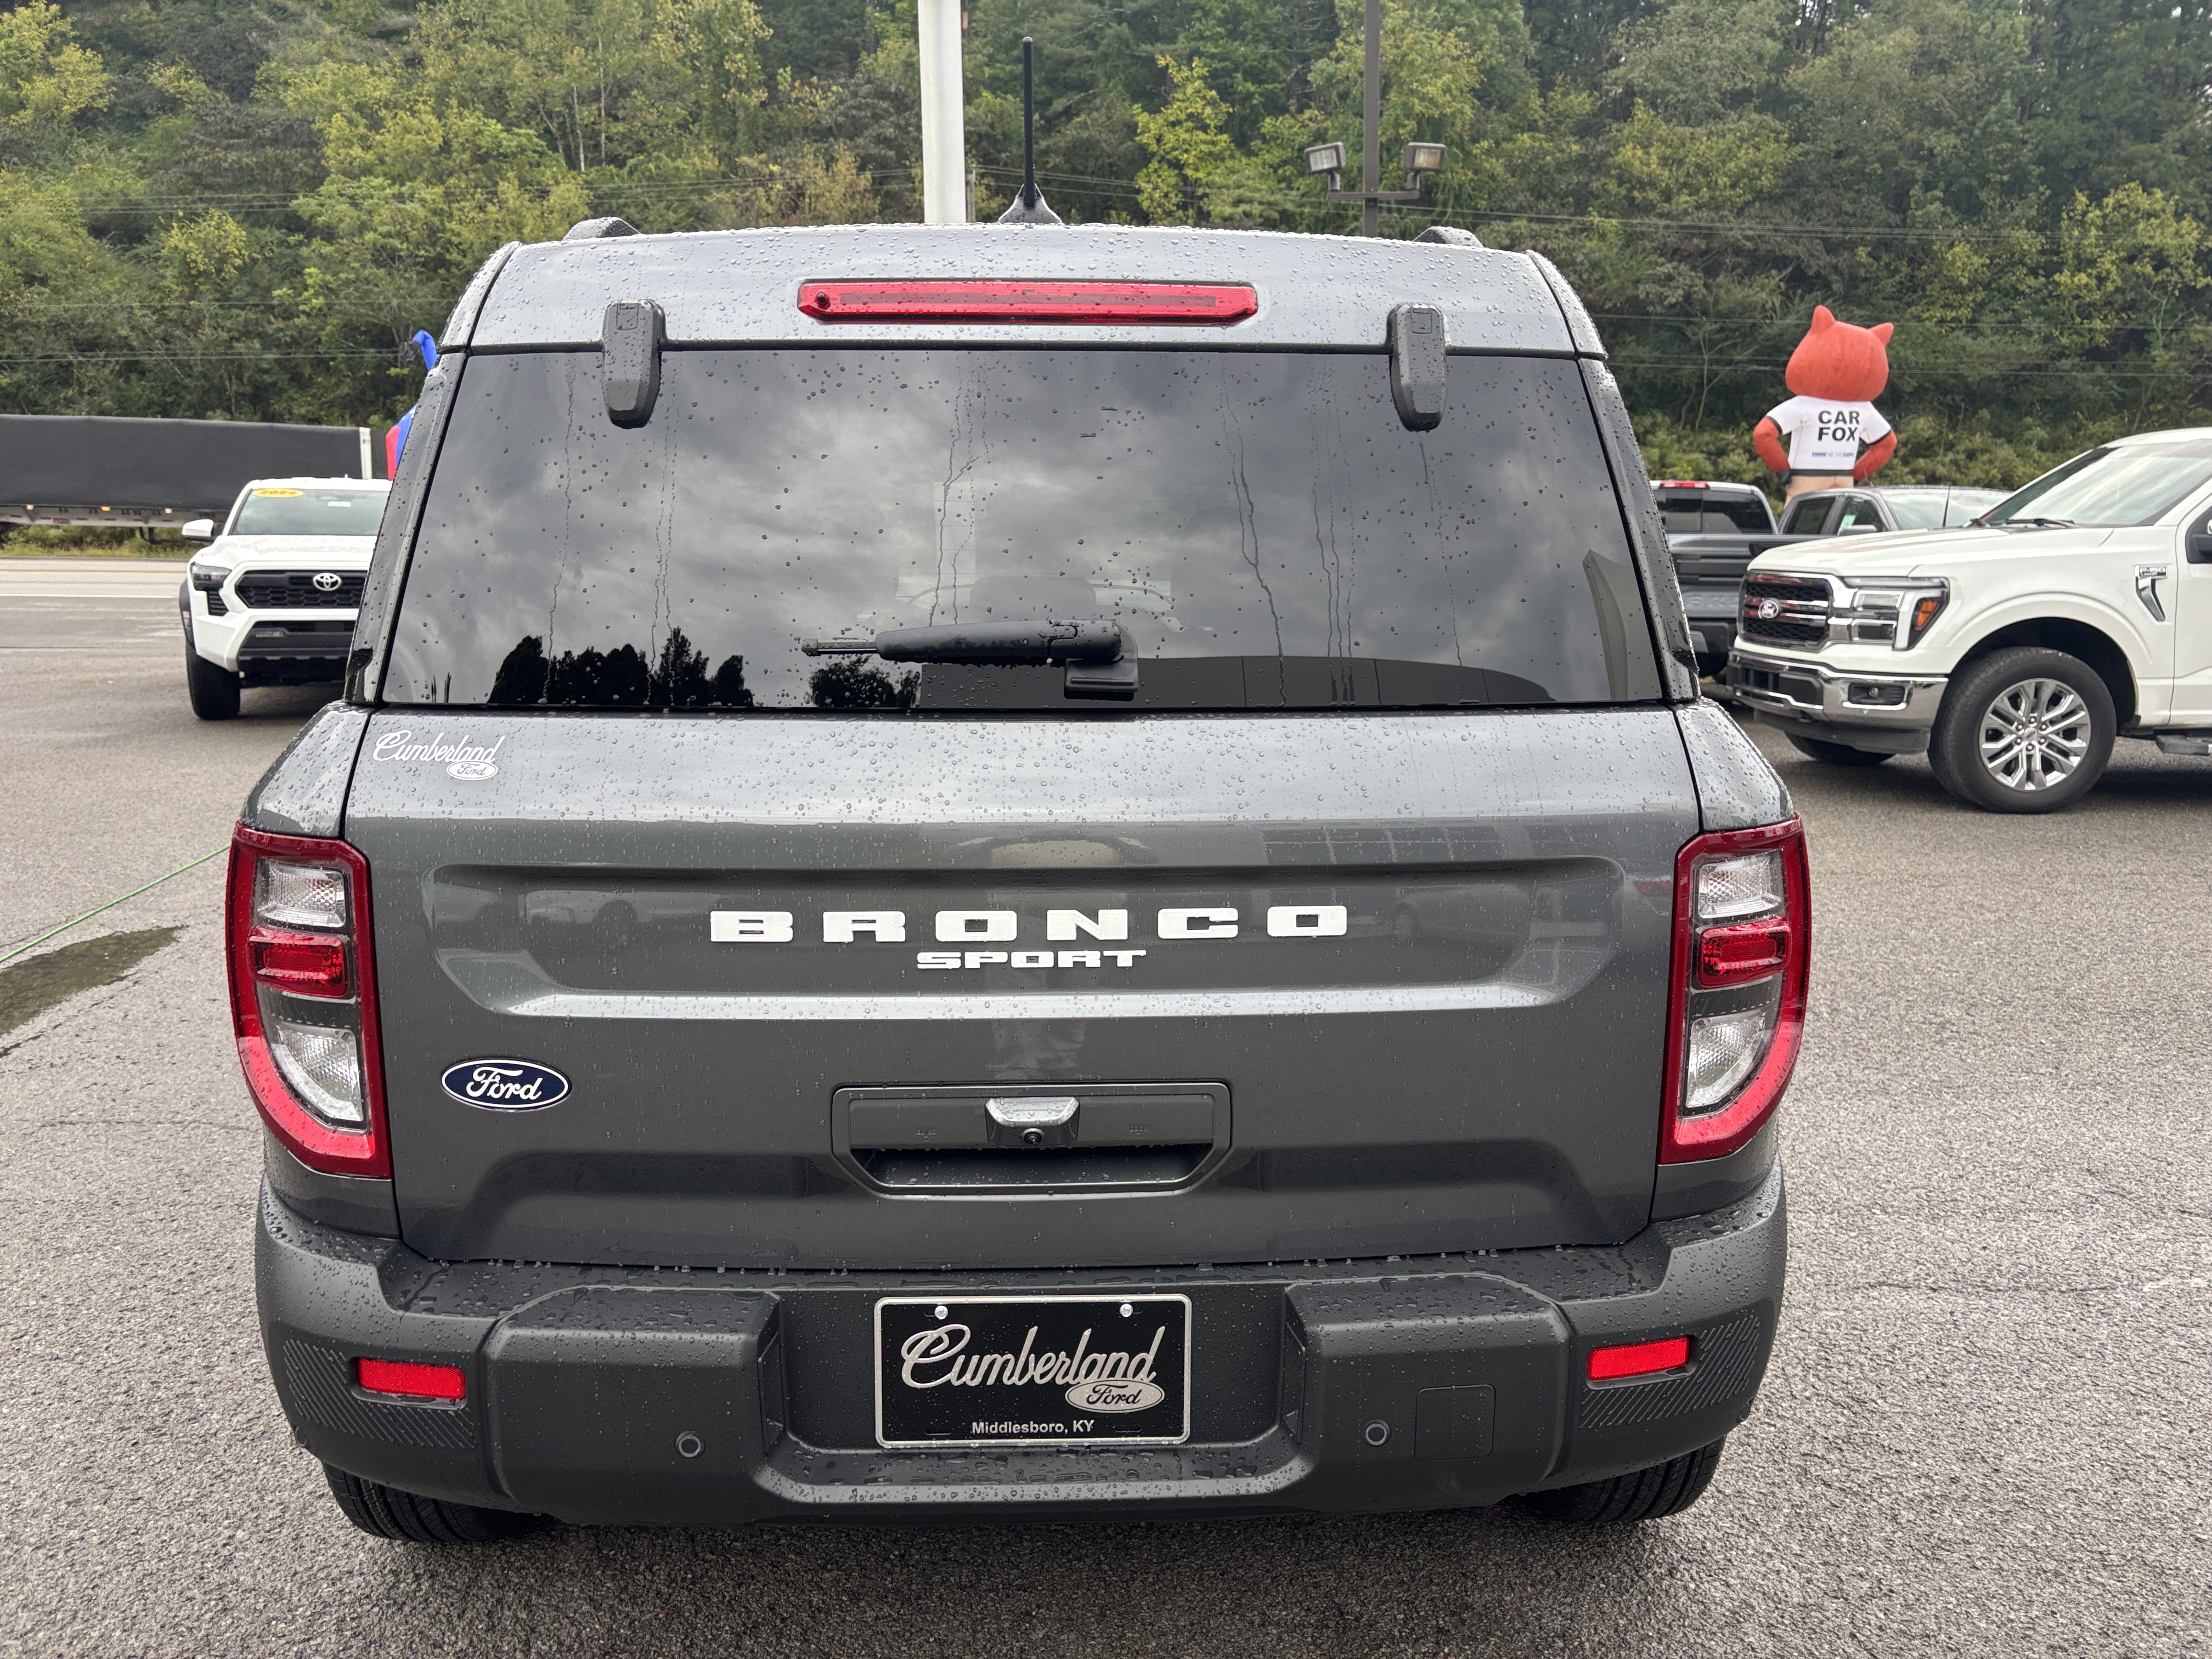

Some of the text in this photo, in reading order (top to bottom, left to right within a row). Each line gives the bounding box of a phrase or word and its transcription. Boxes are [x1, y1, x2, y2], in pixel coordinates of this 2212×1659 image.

[1818, 410, 1860, 425] CAR
[1818, 427, 1858, 442] FOX
[373, 730, 506, 763] Cumberland
[457, 763, 486, 776] Ford
[710, 906, 1347, 943] BRONCO
[917, 950, 1147, 969] SPORT
[466, 1066, 543, 1100] Ford
[901, 1324, 1165, 1389] Cumberland
[1086, 1384, 1142, 1405] Ford
[972, 1420, 1094, 1435] Middlesboro, KY
